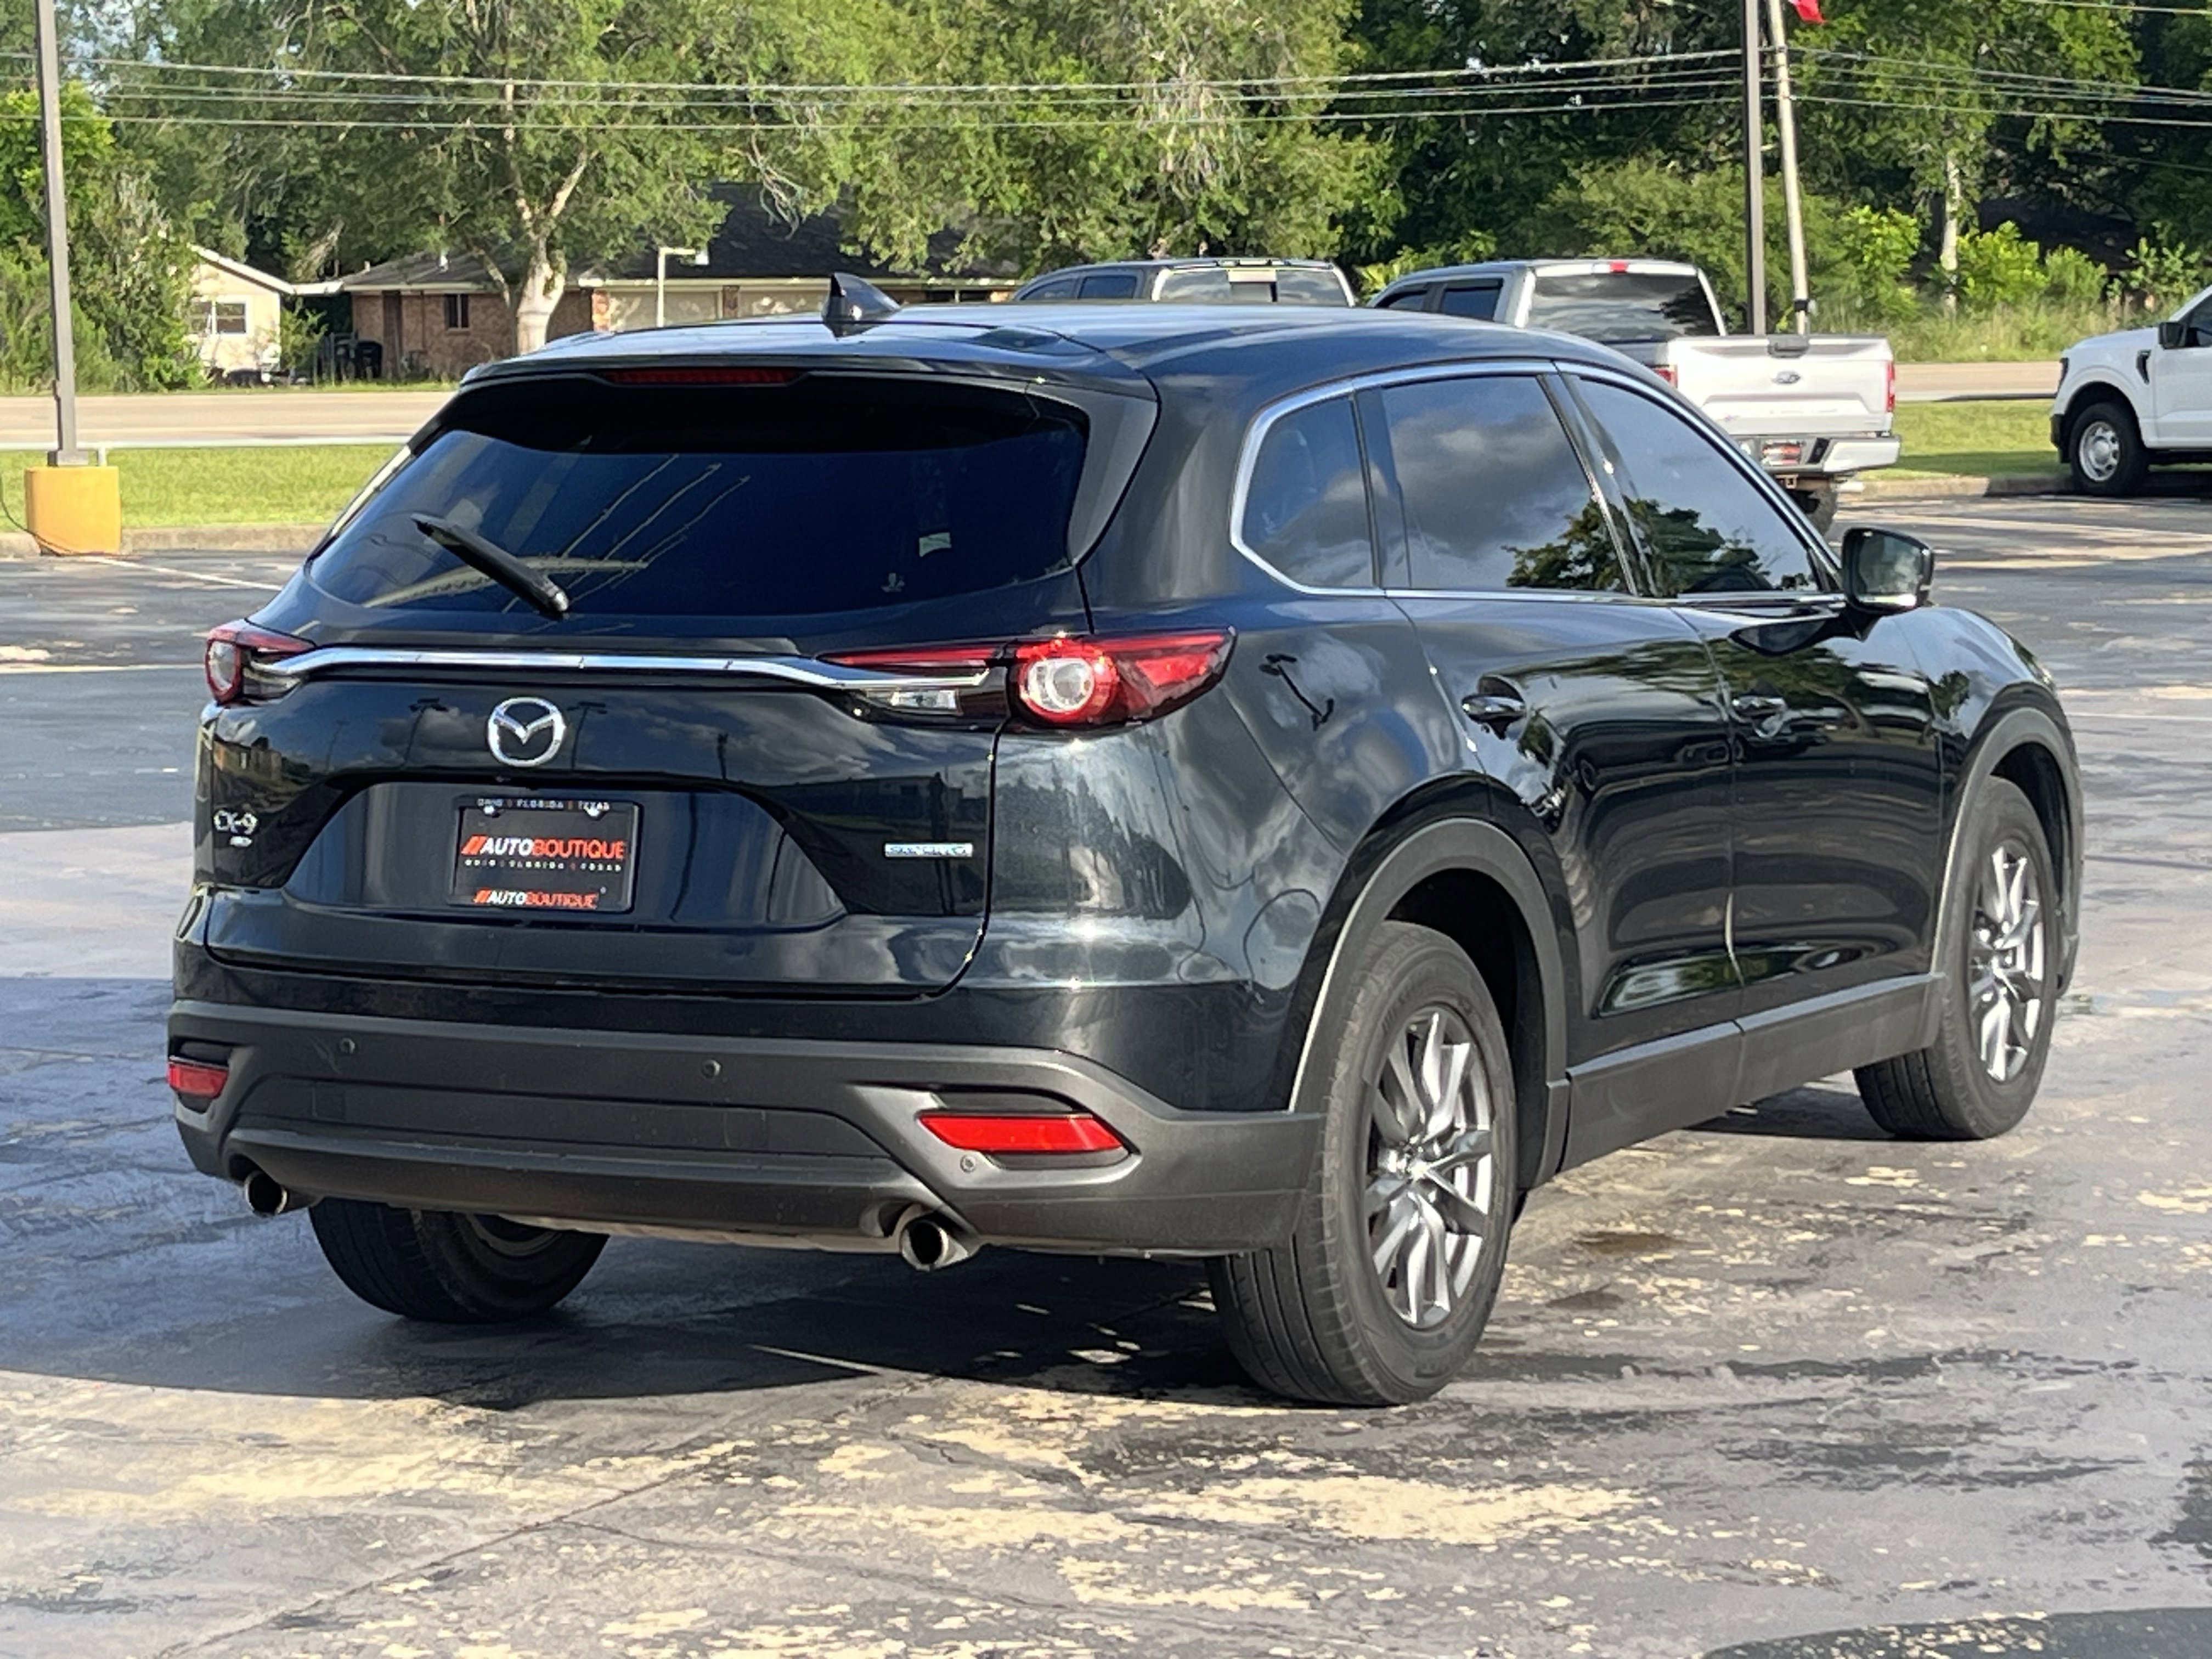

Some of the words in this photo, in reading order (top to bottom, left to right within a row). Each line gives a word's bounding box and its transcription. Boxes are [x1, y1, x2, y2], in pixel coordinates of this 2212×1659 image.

[213, 810, 258, 835] CX-9
[479, 837, 626, 861] AUTOBOUTIQUE
[487, 890, 598, 909] AUTOBOUTIQUE
